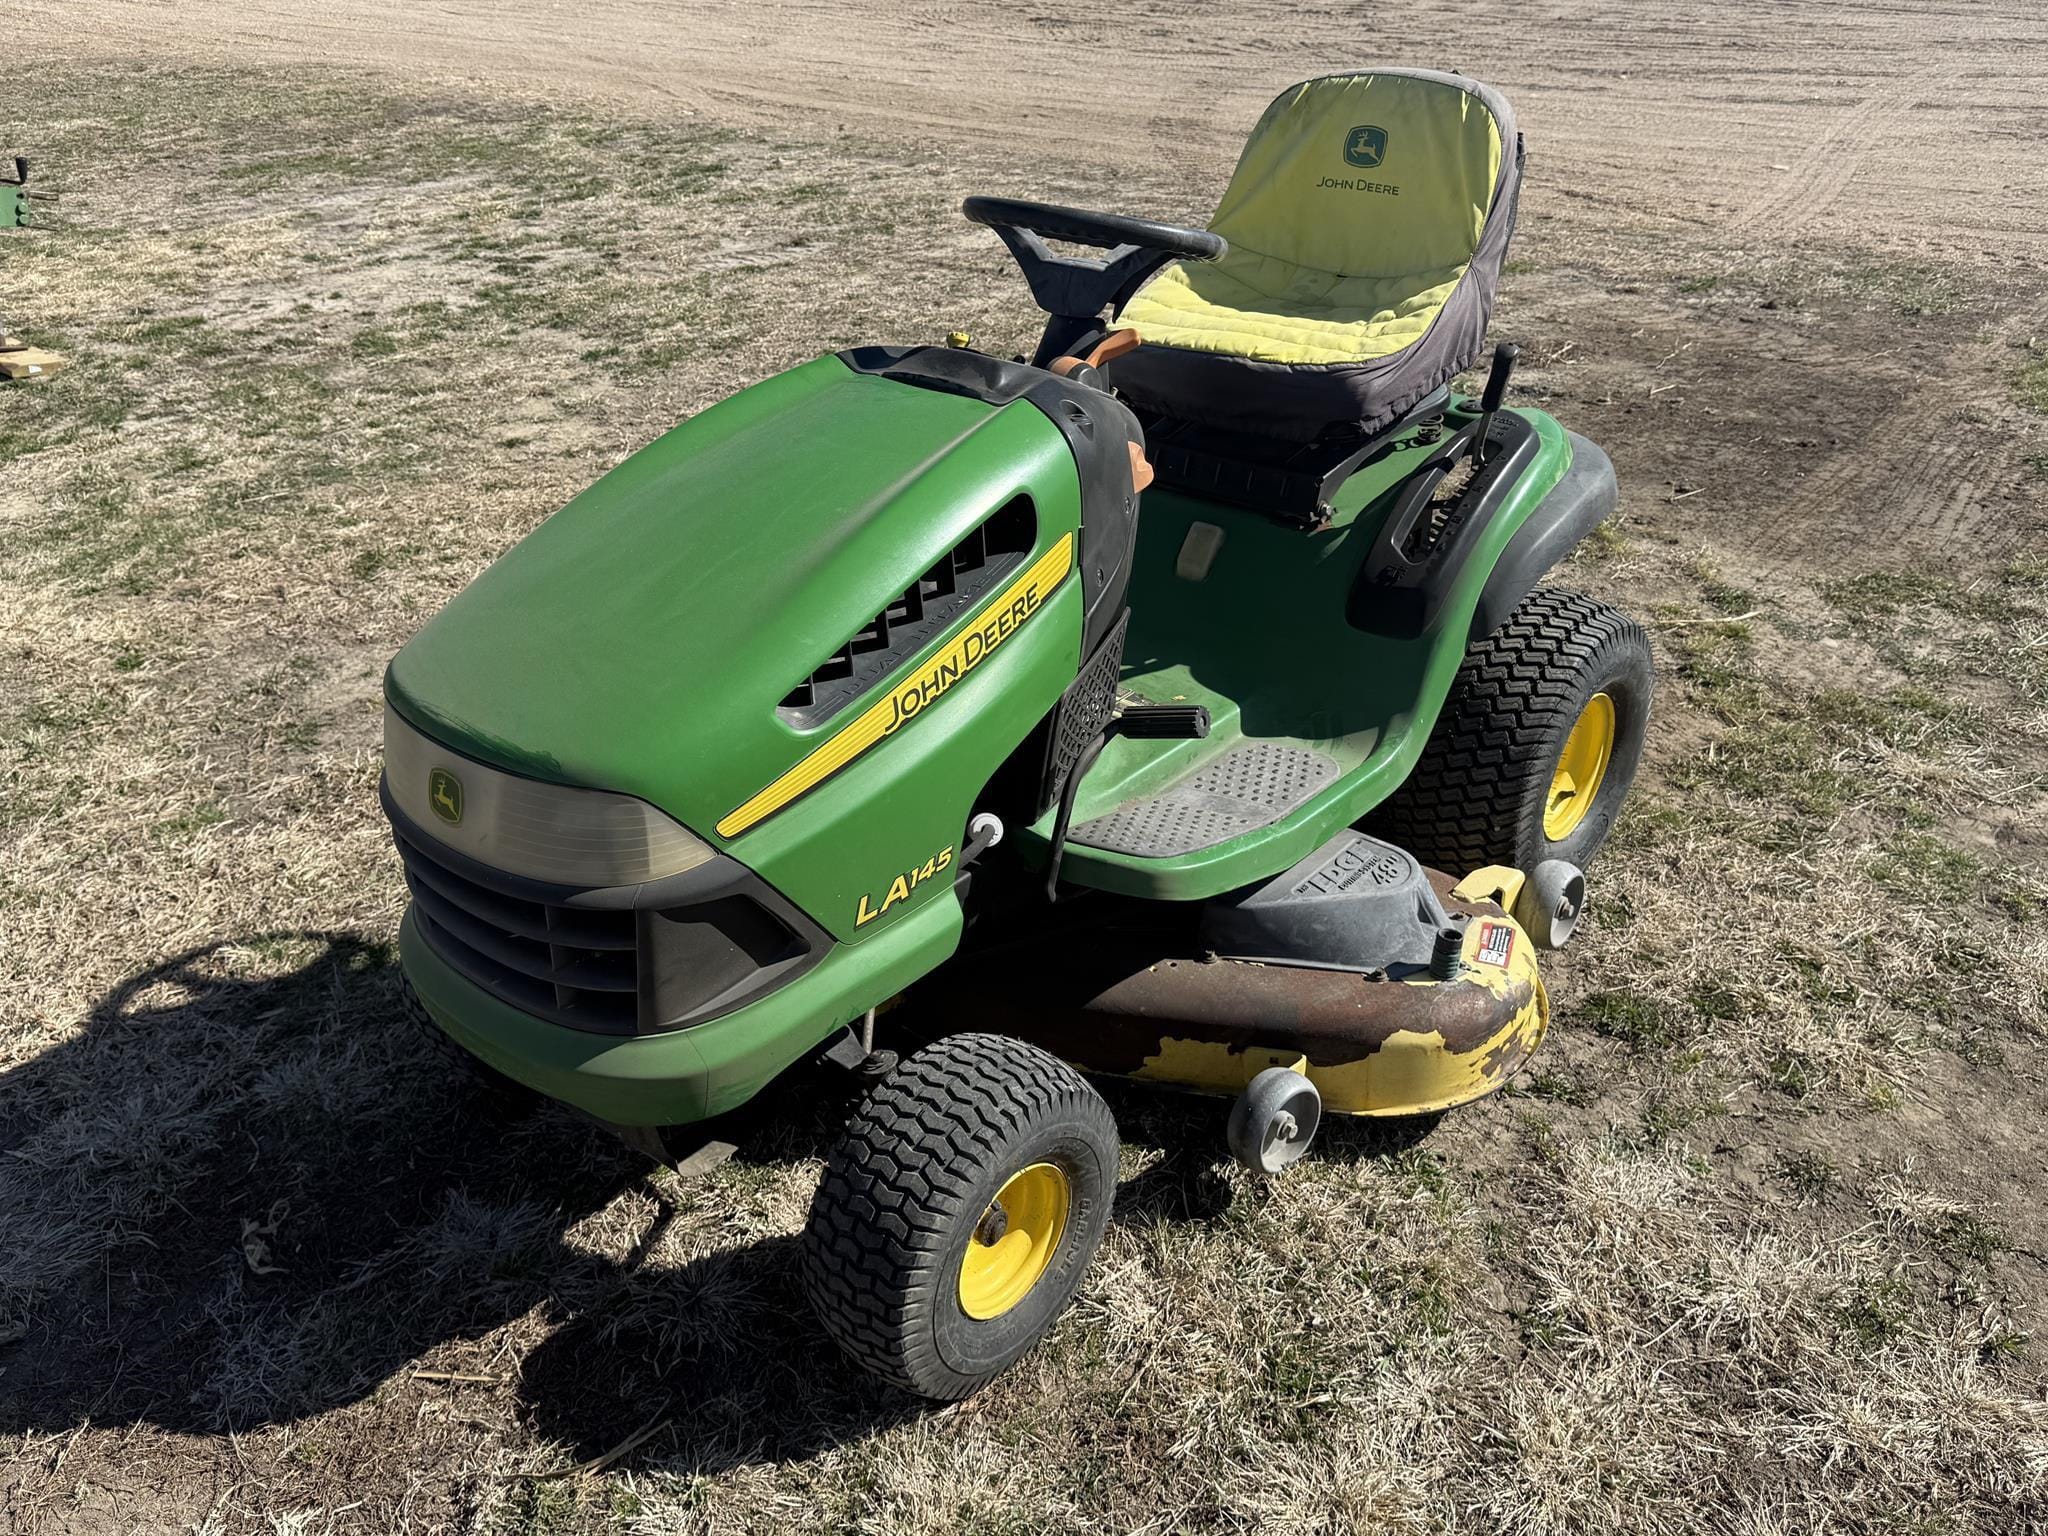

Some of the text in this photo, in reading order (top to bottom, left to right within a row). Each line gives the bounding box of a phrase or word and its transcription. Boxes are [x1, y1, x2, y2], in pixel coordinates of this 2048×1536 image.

[1316, 176, 1400, 196] JOHN DEERE
[884, 582, 1042, 733] JOHN DEERE
[854, 843, 954, 929] LA145
